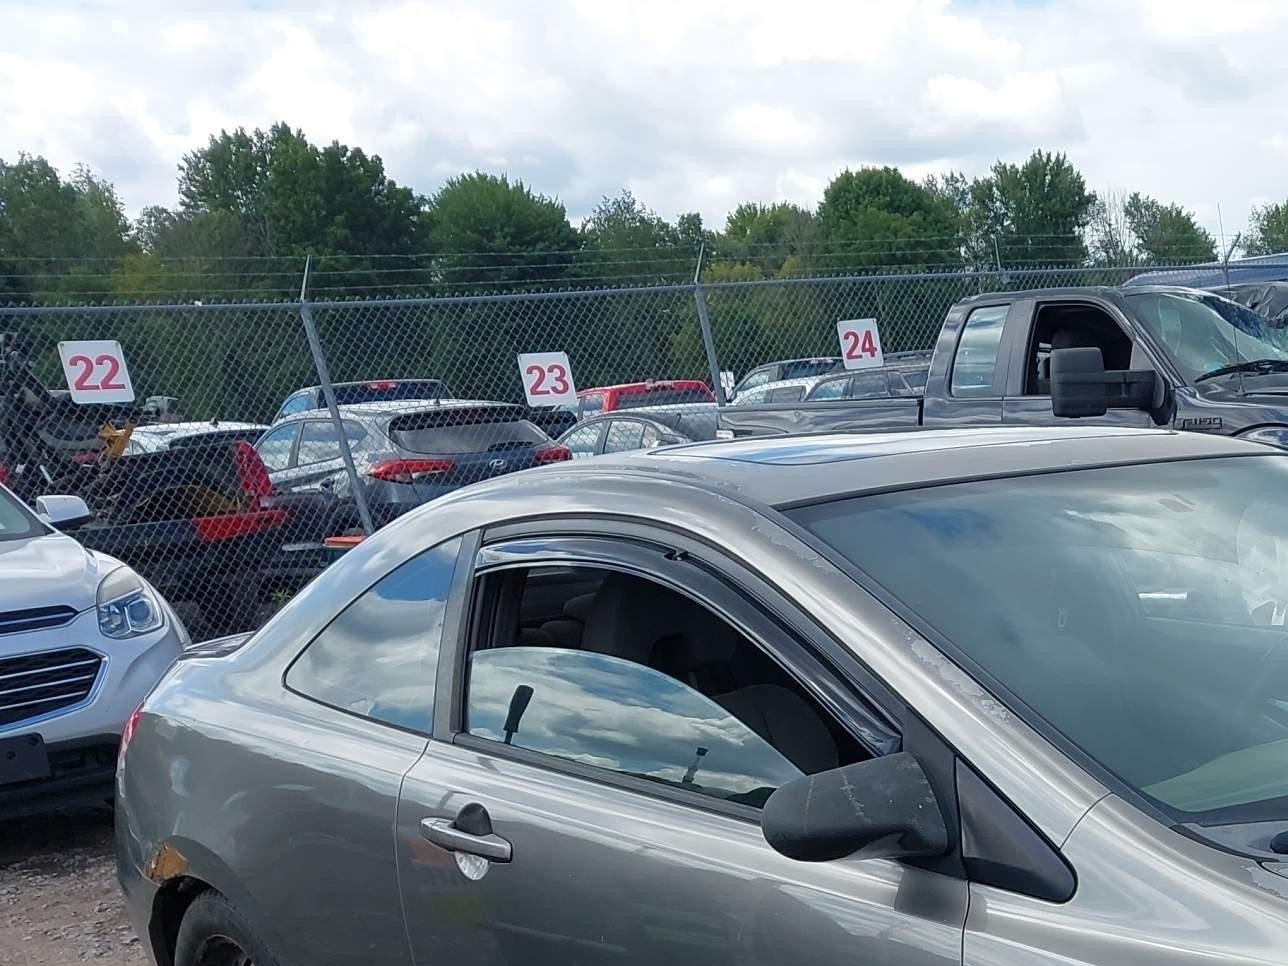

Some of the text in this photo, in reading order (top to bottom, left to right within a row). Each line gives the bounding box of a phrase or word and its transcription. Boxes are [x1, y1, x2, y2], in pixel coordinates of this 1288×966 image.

[843, 329, 878, 360] 24
[68, 354, 126, 391] 22
[525, 363, 570, 396] 23
